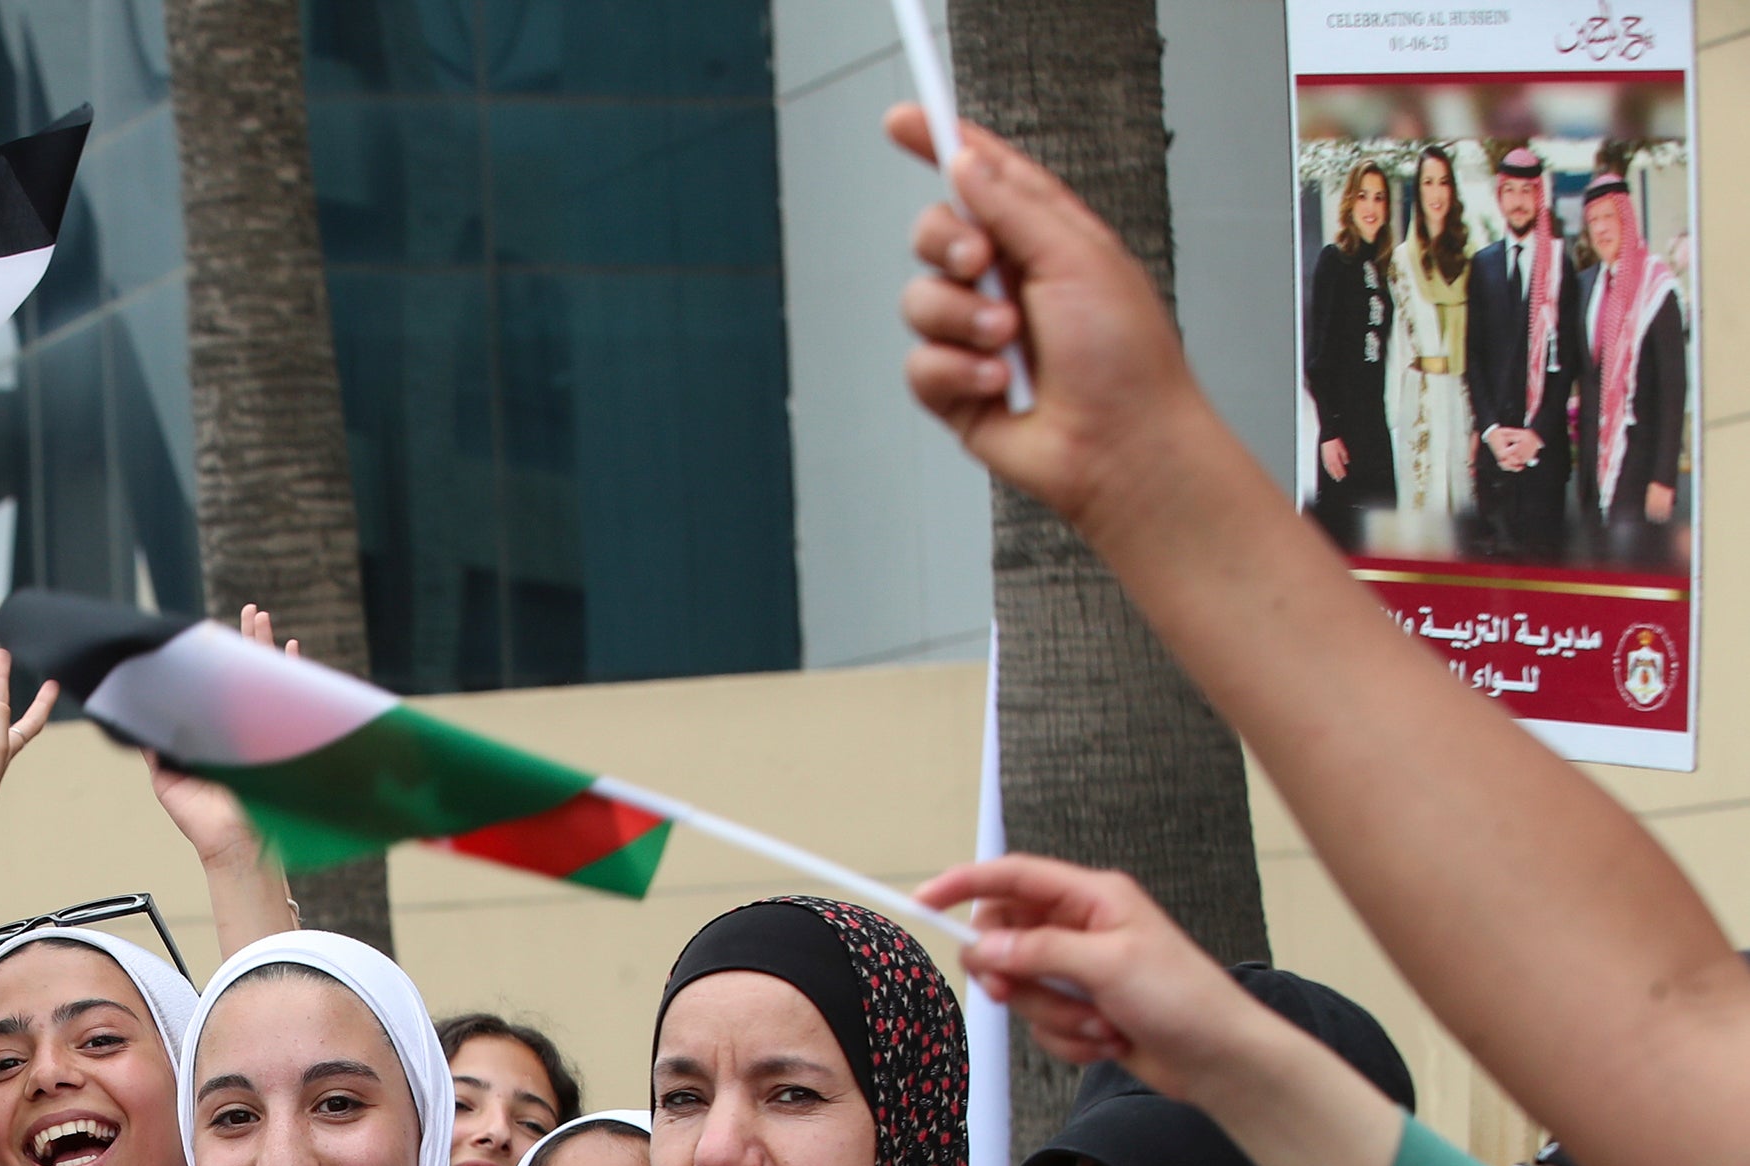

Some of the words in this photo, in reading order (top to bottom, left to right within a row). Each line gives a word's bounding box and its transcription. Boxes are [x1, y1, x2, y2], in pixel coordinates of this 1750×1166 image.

[1327, 12, 1424, 29] CELEBRATING
[1426, 12, 1446, 28] AL
[1449, 9, 1510, 27] HUSSEIN
[1389, 35, 1449, 52] 01-06-23
[1418, 606, 1509, 650] التربية
[1514, 613, 1603, 657] مديرية
[1470, 661, 1541, 698] للواء
